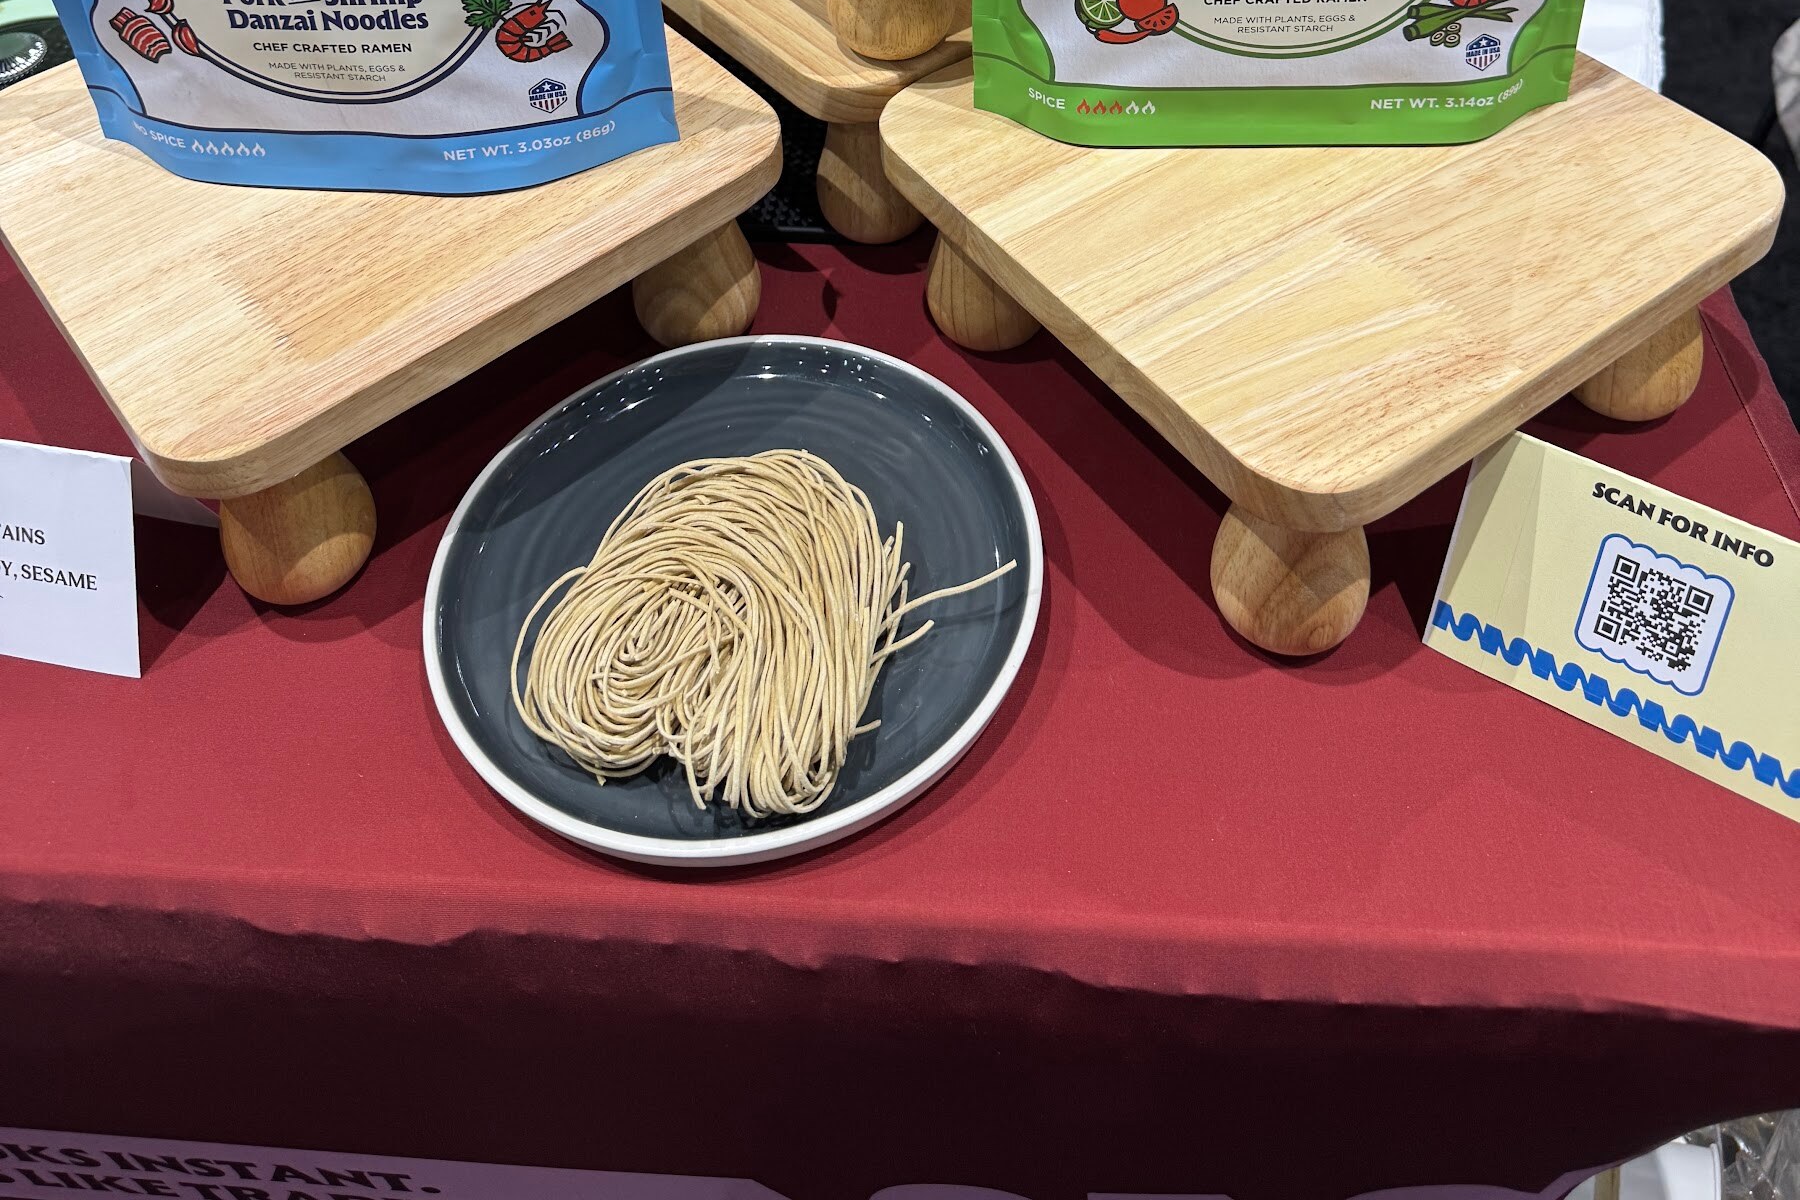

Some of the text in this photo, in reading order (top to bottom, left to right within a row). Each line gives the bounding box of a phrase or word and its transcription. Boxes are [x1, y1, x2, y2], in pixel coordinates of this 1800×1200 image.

[226, 9, 429, 31] Danzai Noodles
[1214, 14, 1356, 24] MADE WITH PLANTS, EGGS &
[1237, 24, 1334, 34] RESISTANT STARCH
[253, 42, 412, 54] CHEF CRAFTED RAMEN
[268, 62, 406, 73] MADE WITH PLANTS, EGGS &
[294, 71, 386, 82] RESISTANT STARCH
[1028, 87, 1065, 110] SPICE
[1370, 99, 1404, 110] NET
[1409, 97, 1440, 109] WT.
[1444, 95, 1494, 109] 3.14oz
[150, 129, 186, 148] SPICE
[443, 120, 616, 162] NET WT. 3.03oz (86g)
[0, 523, 46, 545] AINS
[1591, 482, 1774, 568] SCAN FOR INFO
[21, 564, 98, 591] SESAME
[0, 1142, 101, 1167] KS
[102, 1150, 441, 1195] INSTANT.
[17, 1167, 181, 1199] LIKE
